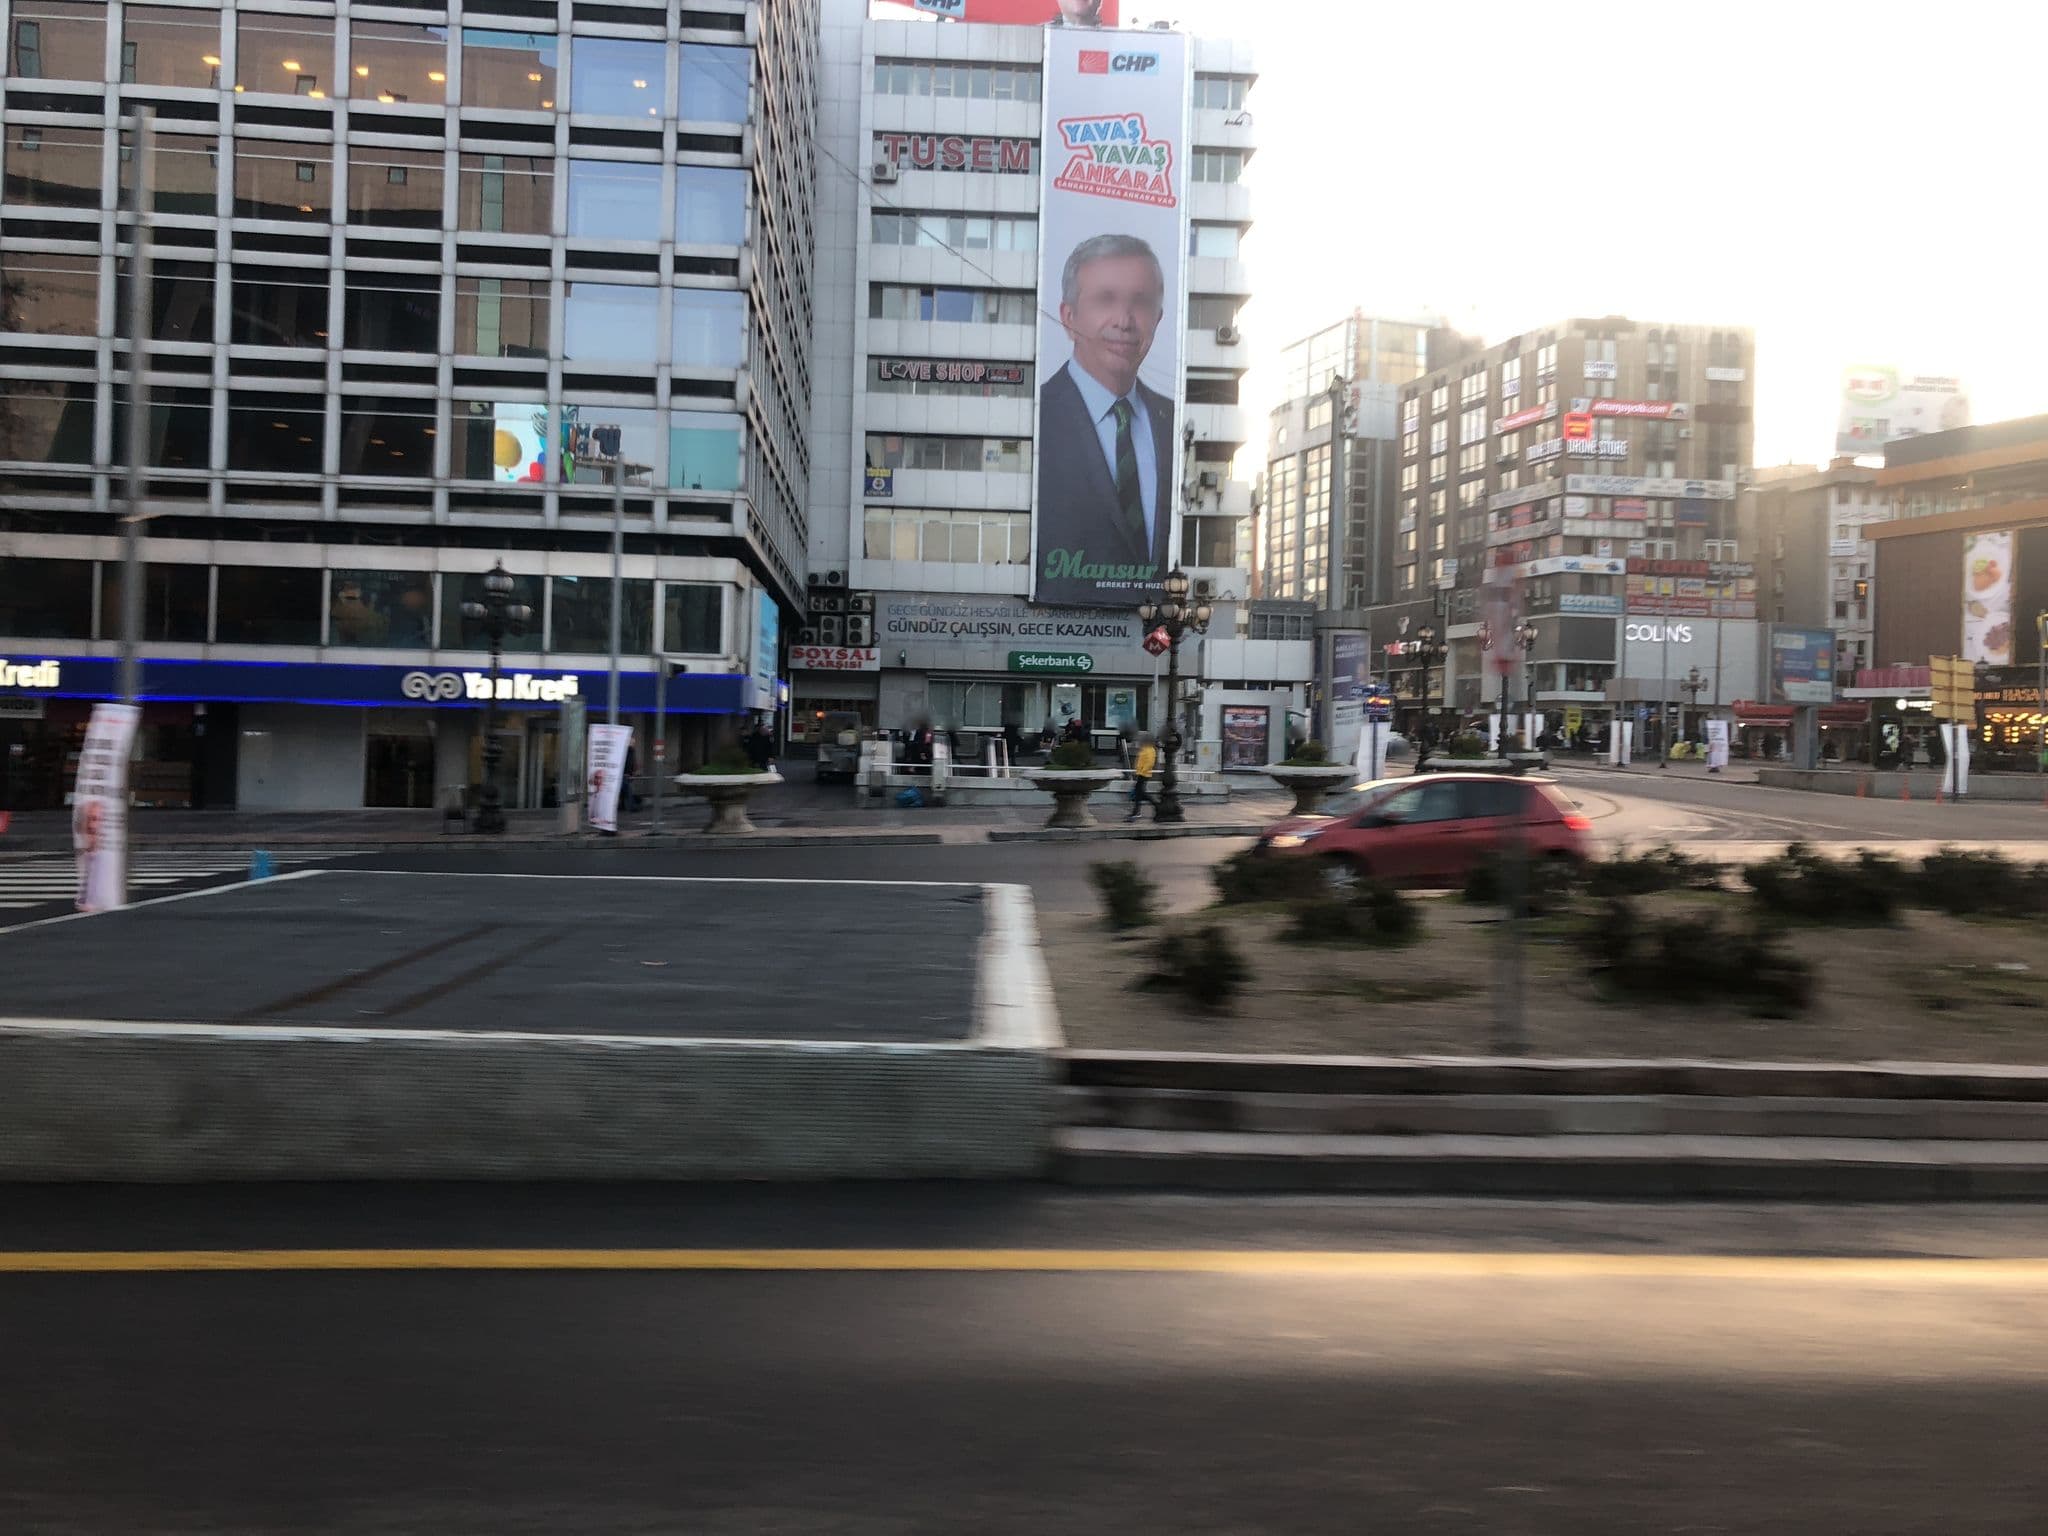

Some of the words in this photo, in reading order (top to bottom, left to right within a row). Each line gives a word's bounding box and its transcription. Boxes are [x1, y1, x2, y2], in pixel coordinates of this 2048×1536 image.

[1112, 55, 1156, 72] CHP
[1065, 119, 1140, 145] YAVAŞ
[882, 134, 1031, 170] TUSEM
[1093, 144, 1166, 172] YAVAŞ
[1070, 161, 1164, 193] ANKARA
[936, 362, 985, 382] SHOP
[1598, 441, 1628, 456] STORE
[1044, 548, 1158, 580] Mansur
[1096, 581, 1131, 589] BEREKET
[888, 618, 947, 634] GÜNDÜZ
[950, 621, 1014, 638] ÇALIŞSIN,
[1018, 622, 1053, 635] GECE
[1056, 624, 1130, 638] KAZANSIN.
[1625, 623, 1692, 643] COLIN'S
[791, 647, 876, 661] SOYSAL
[1019, 654, 1076, 668] Şekerbank
